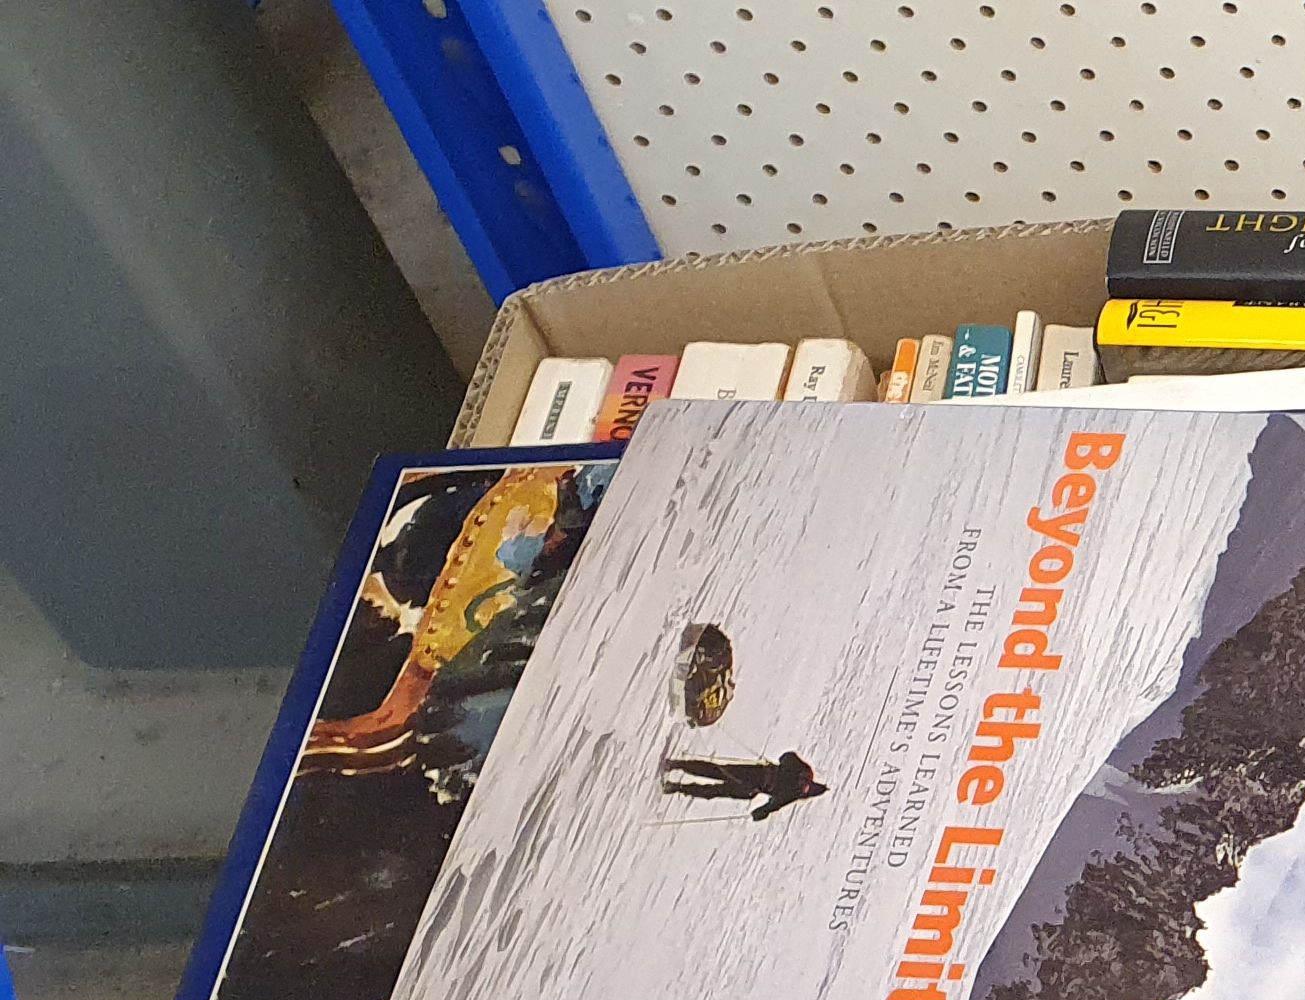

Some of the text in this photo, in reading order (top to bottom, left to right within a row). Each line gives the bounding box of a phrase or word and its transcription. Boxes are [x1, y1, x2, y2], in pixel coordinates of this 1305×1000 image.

[946, 525, 982, 592] FROM
[996, 430, 1126, 670] Beyond
[886, 586, 996, 869] THE LESSONS LEARNED
[890, 620, 945, 755] LIFETIME'S
[956, 688, 1042, 807] the
[827, 760, 903, 933] ADVENTURES
